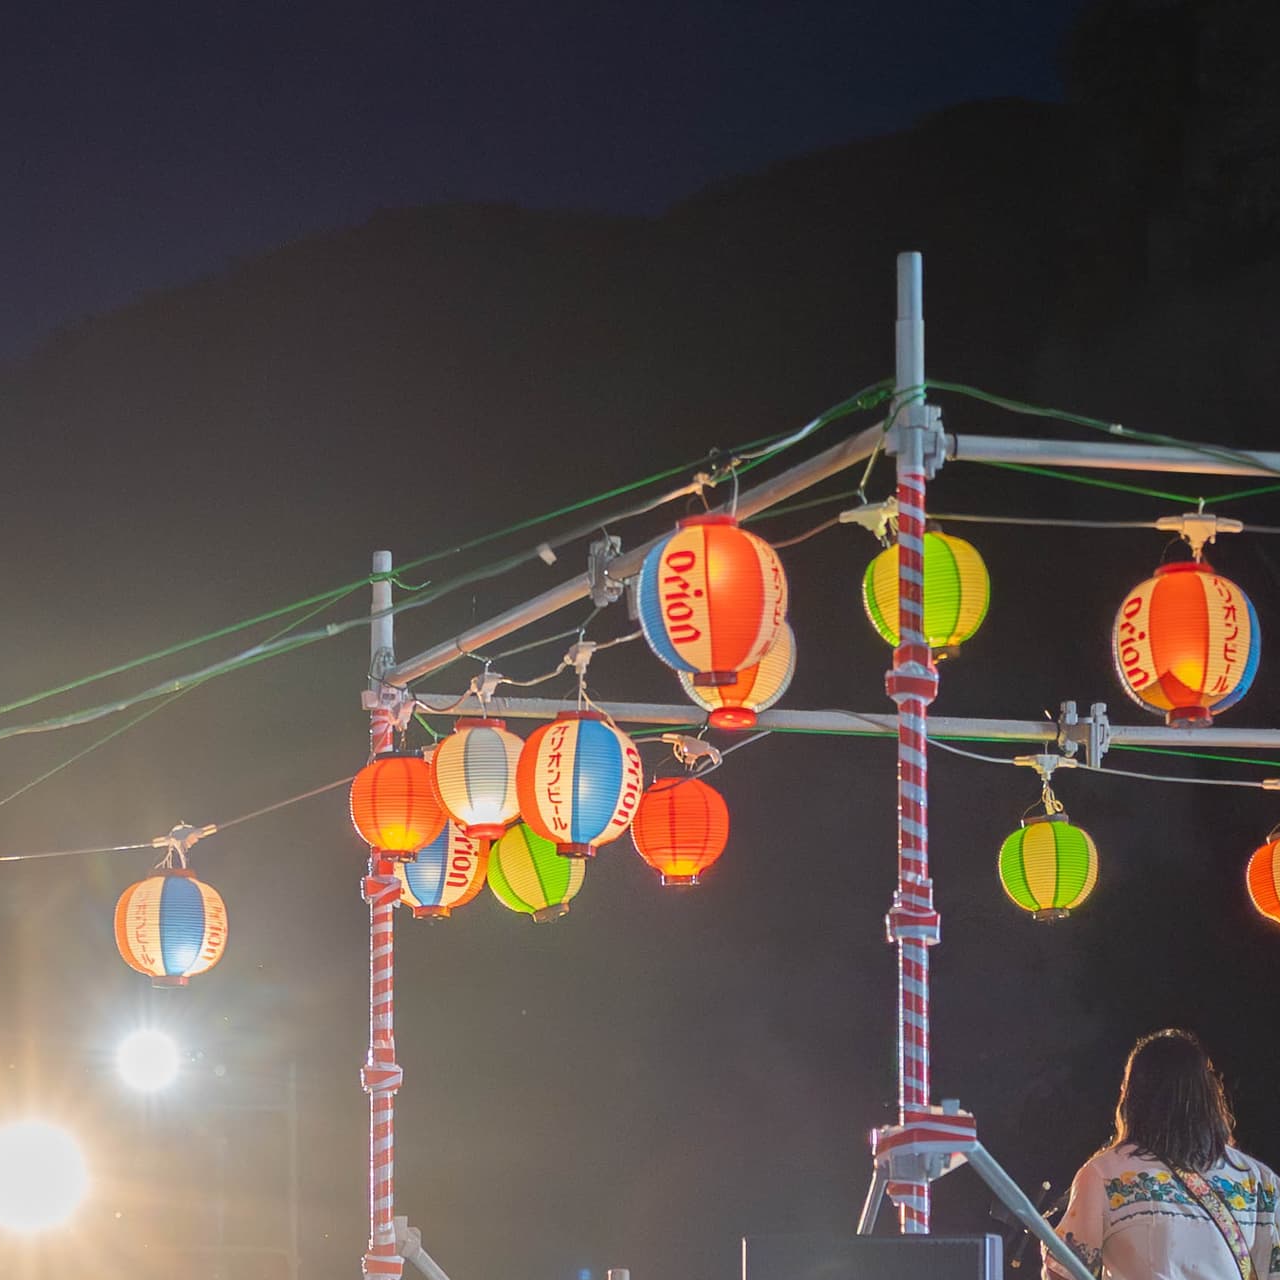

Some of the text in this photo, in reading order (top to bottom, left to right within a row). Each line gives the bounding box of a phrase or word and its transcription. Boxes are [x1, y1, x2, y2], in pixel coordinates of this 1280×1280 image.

[664, 551, 703, 644] Orion
[1120, 597, 1149, 688] Orion
[547, 726, 569, 831] オリオンビール
[613, 747, 640, 827] Orion
